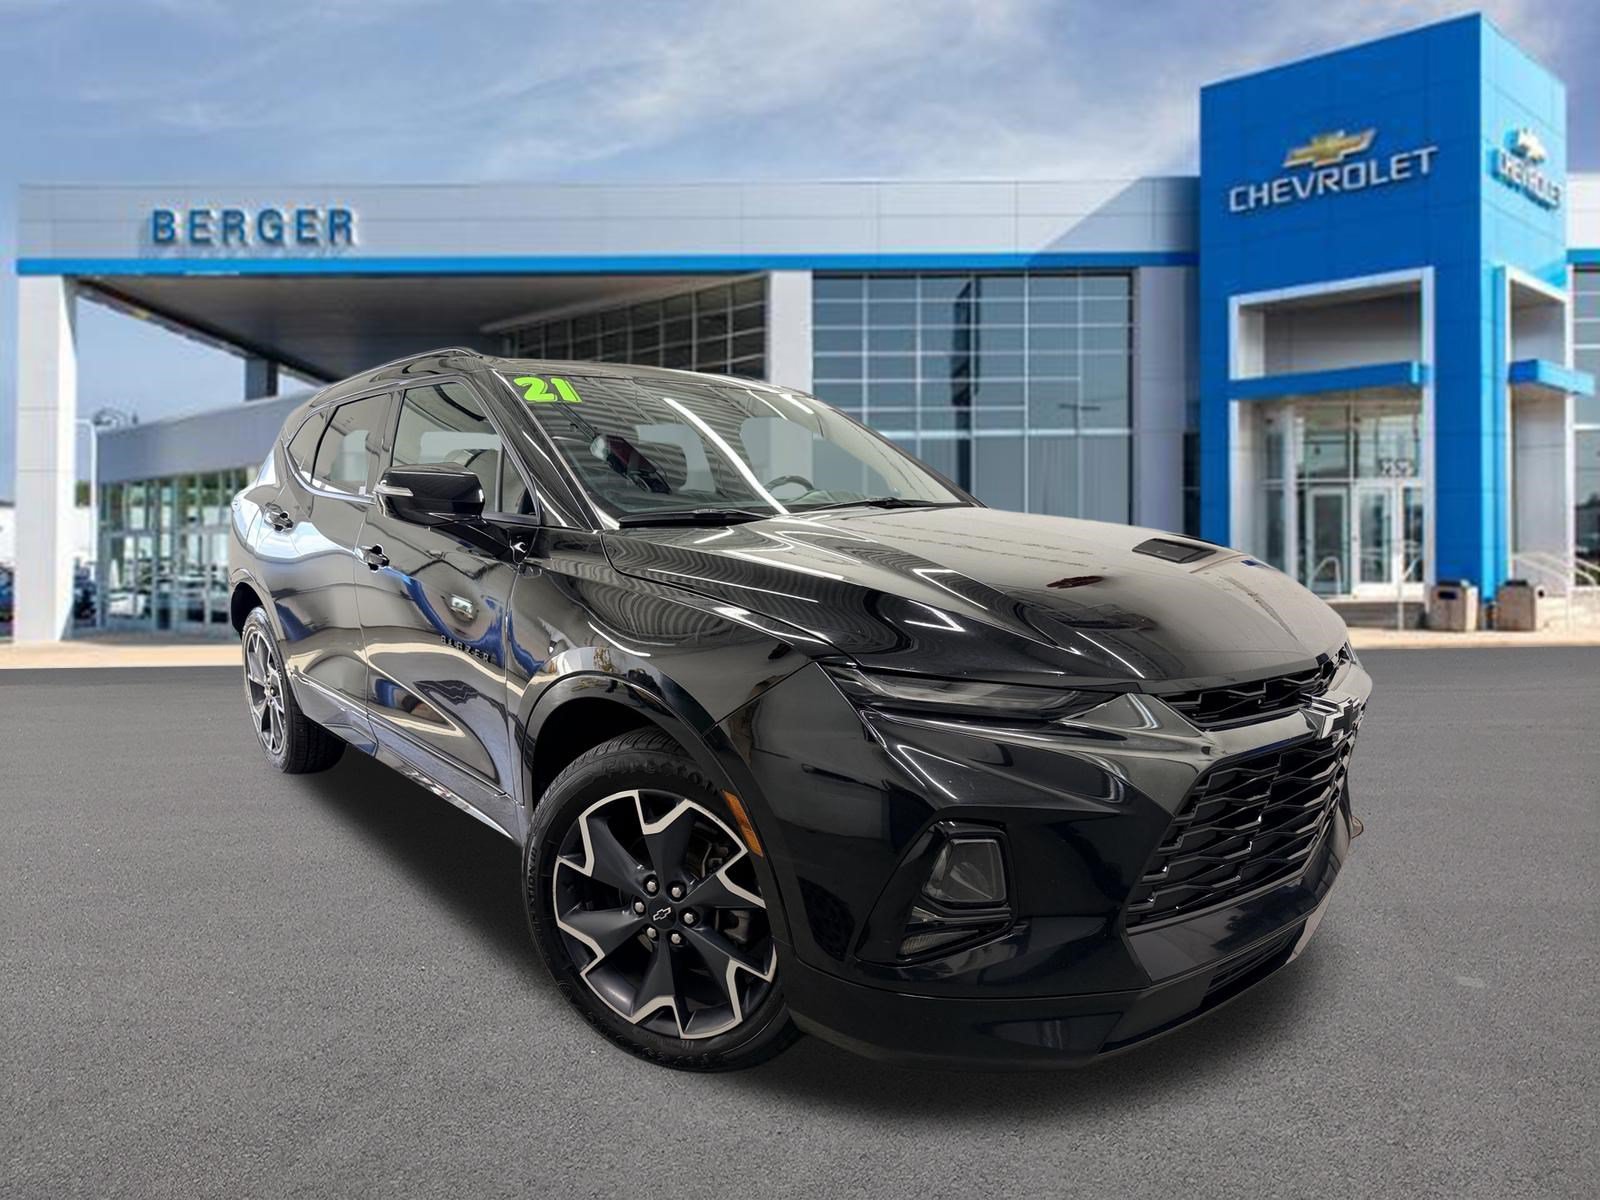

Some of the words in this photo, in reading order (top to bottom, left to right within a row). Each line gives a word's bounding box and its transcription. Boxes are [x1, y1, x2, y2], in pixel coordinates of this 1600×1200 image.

[1229, 145, 1438, 212] CHEVROLET
[152, 208, 355, 245] BERGER
[513, 376, 582, 403] 21
